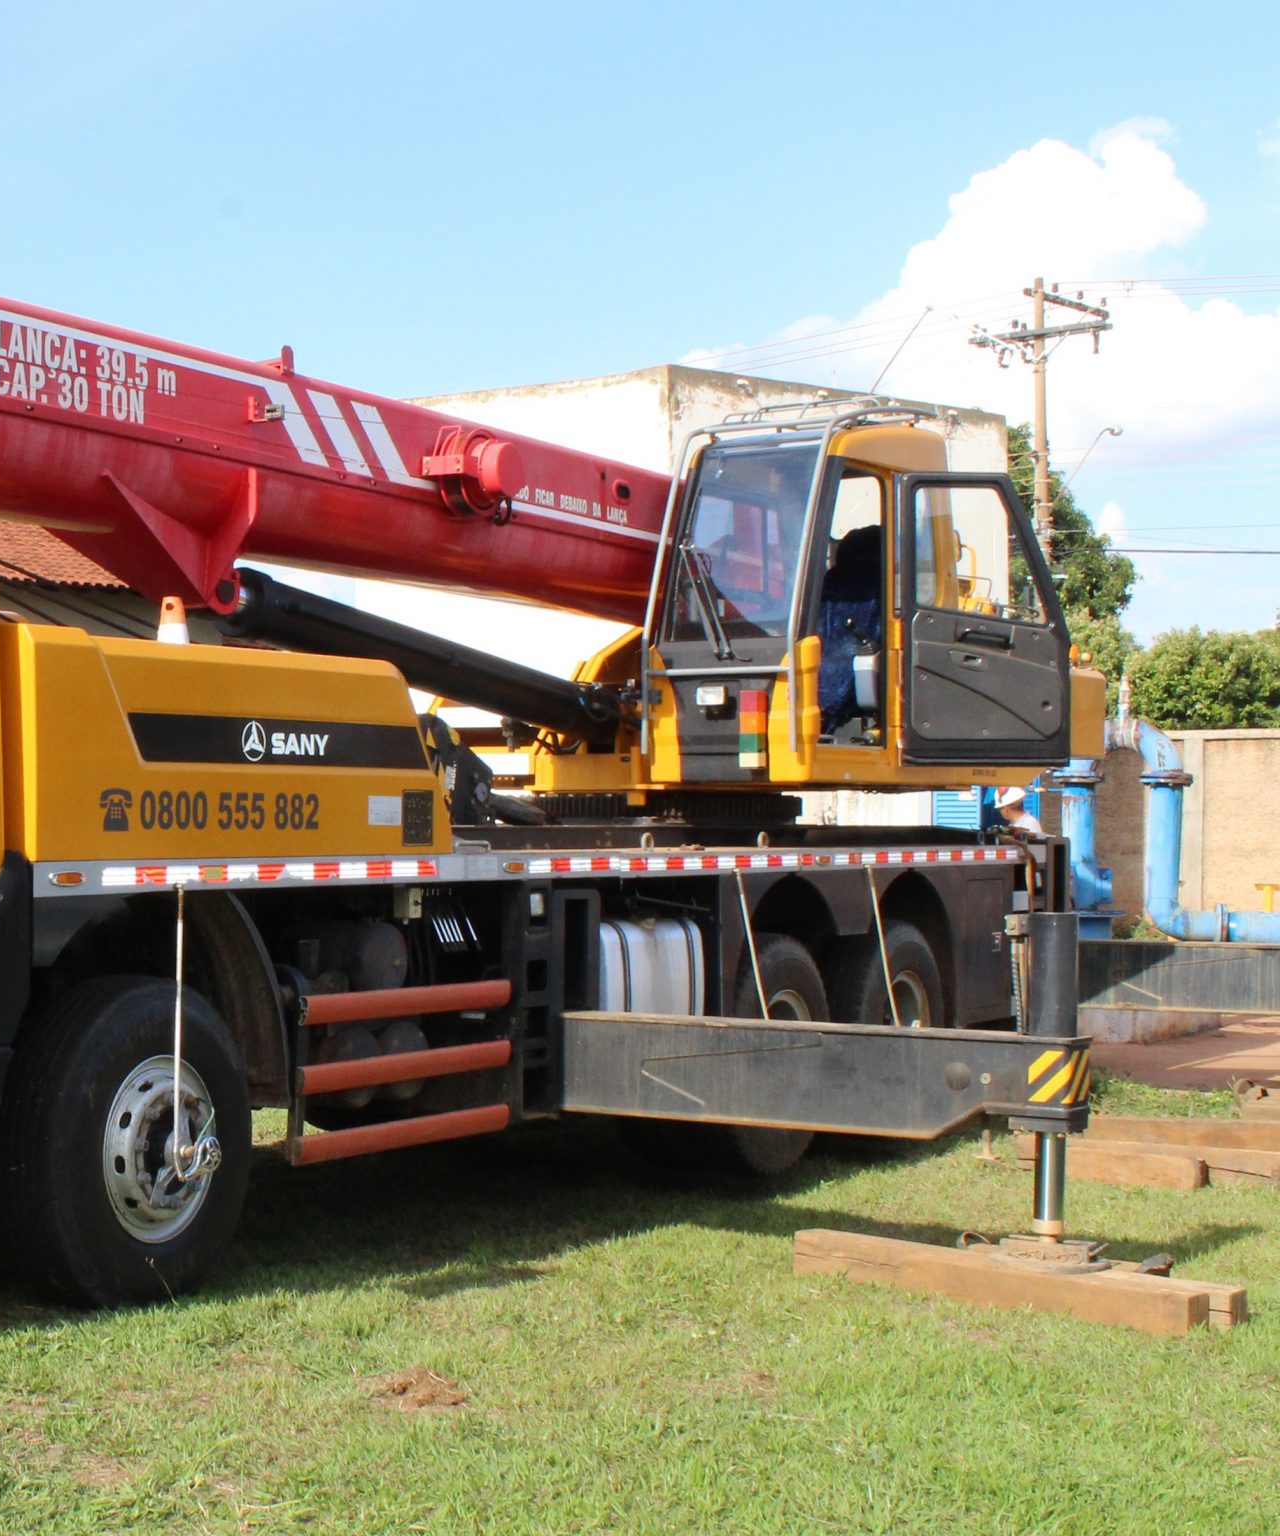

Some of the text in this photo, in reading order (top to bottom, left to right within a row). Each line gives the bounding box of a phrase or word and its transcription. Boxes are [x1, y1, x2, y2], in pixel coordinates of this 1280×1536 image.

[96, 345, 149, 391] 39.5
[157, 367, 177, 397] m
[57, 373, 89, 413] 30
[96, 381, 145, 425] TON
[592, 502, 602, 518] DA
[271, 732, 329, 756] SANY
[140, 790, 320, 830] 0800 555 882
